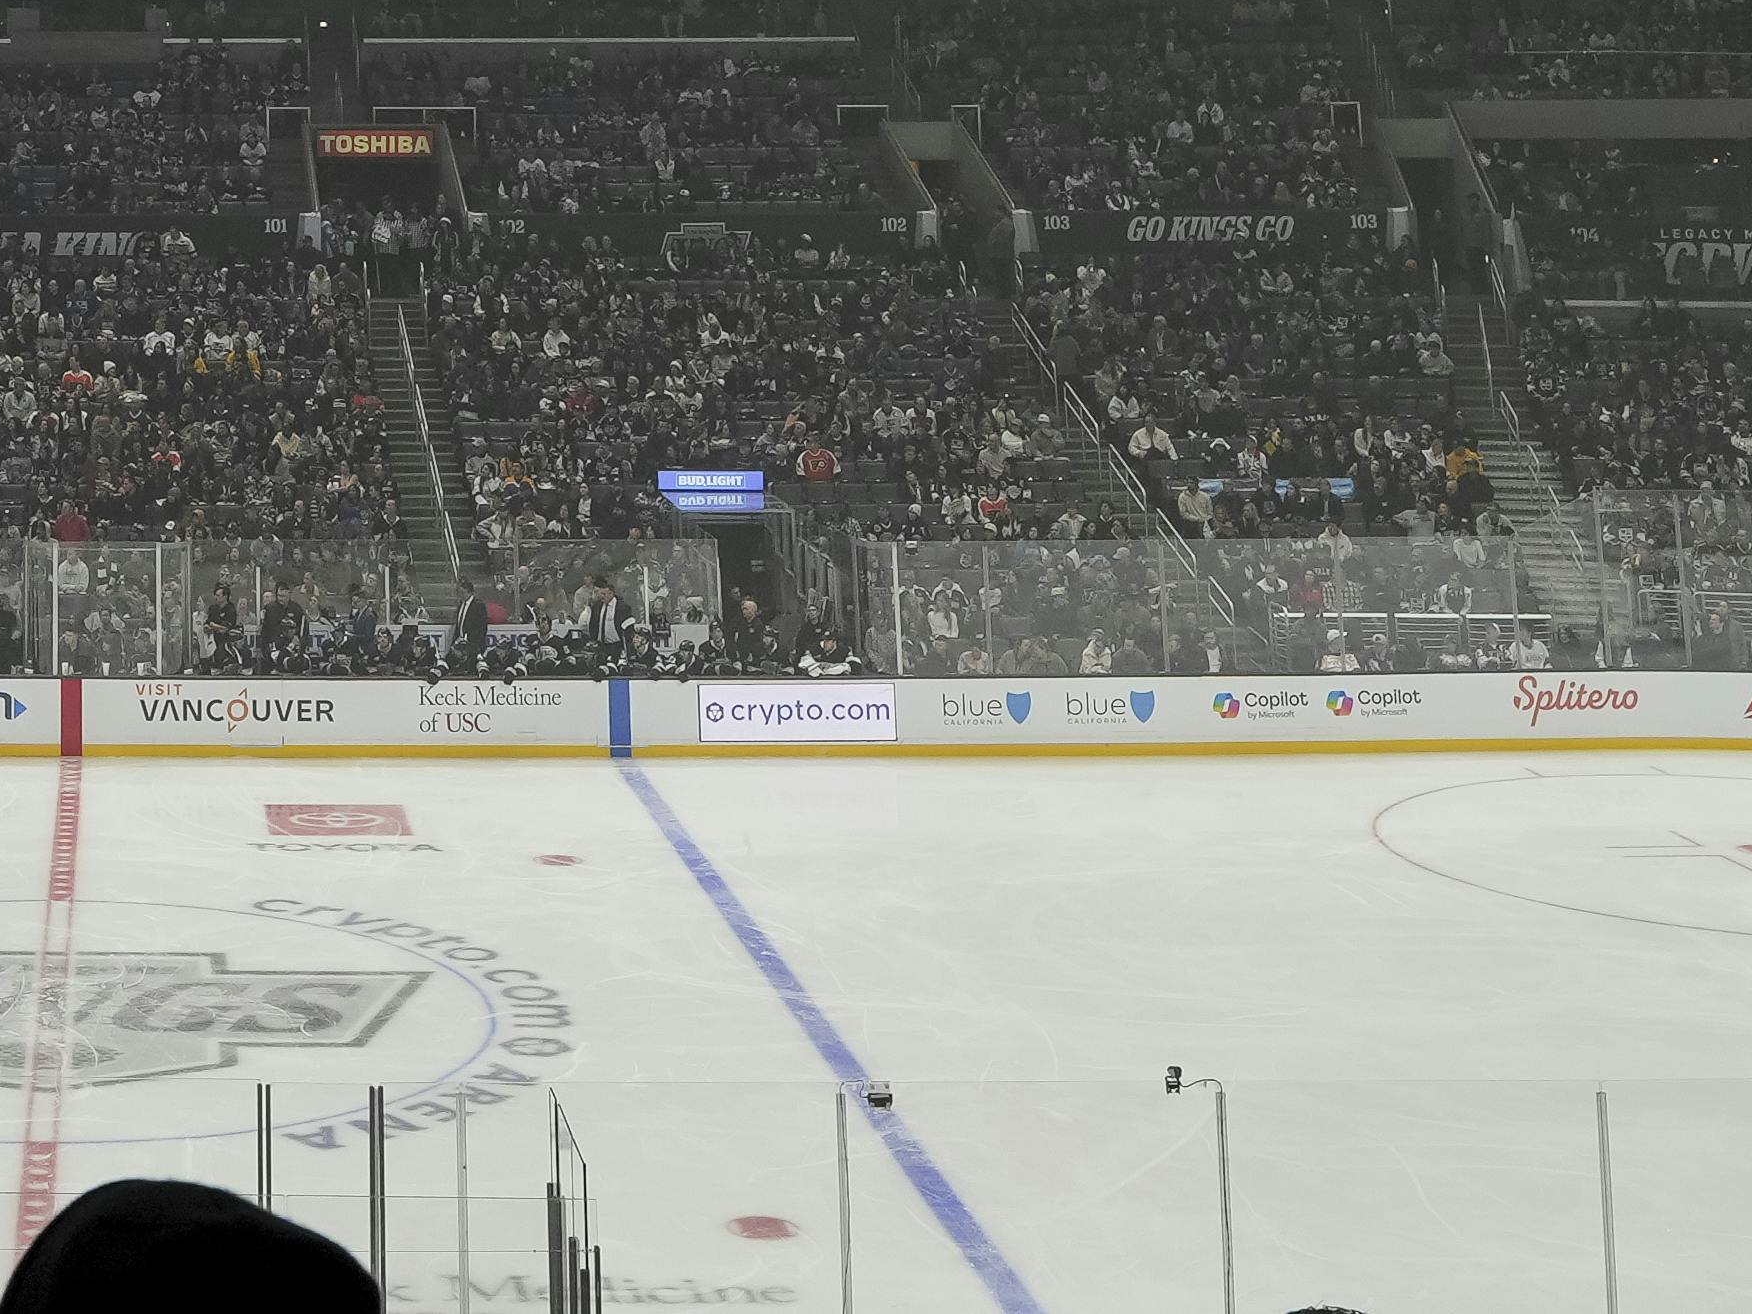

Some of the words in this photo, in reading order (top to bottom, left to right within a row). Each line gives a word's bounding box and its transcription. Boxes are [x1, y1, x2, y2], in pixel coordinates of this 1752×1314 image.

[319, 135, 431, 154] TOSHIBA
[1043, 214, 1070, 231] 103
[1166, 215, 1252, 243] KINGS
[1660, 228, 1734, 242] LEGACY
[135, 683, 183, 696] VISIT
[419, 685, 467, 706] Keck
[472, 685, 561, 706] Medicine
[942, 692, 1002, 716] blue
[1066, 692, 1126, 716] blue
[1244, 690, 1308, 712] Copilot
[1358, 689, 1422, 710] Copilot
[1514, 675, 1638, 727] Splitero
[139, 697, 334, 723] VANCOUVER
[419, 712, 441, 733] of
[446, 713, 491, 733] USC
[731, 699, 890, 725] crypto.com
[1258, 709, 1295, 719] Microsoft
[1371, 707, 1408, 717] Microsoft
